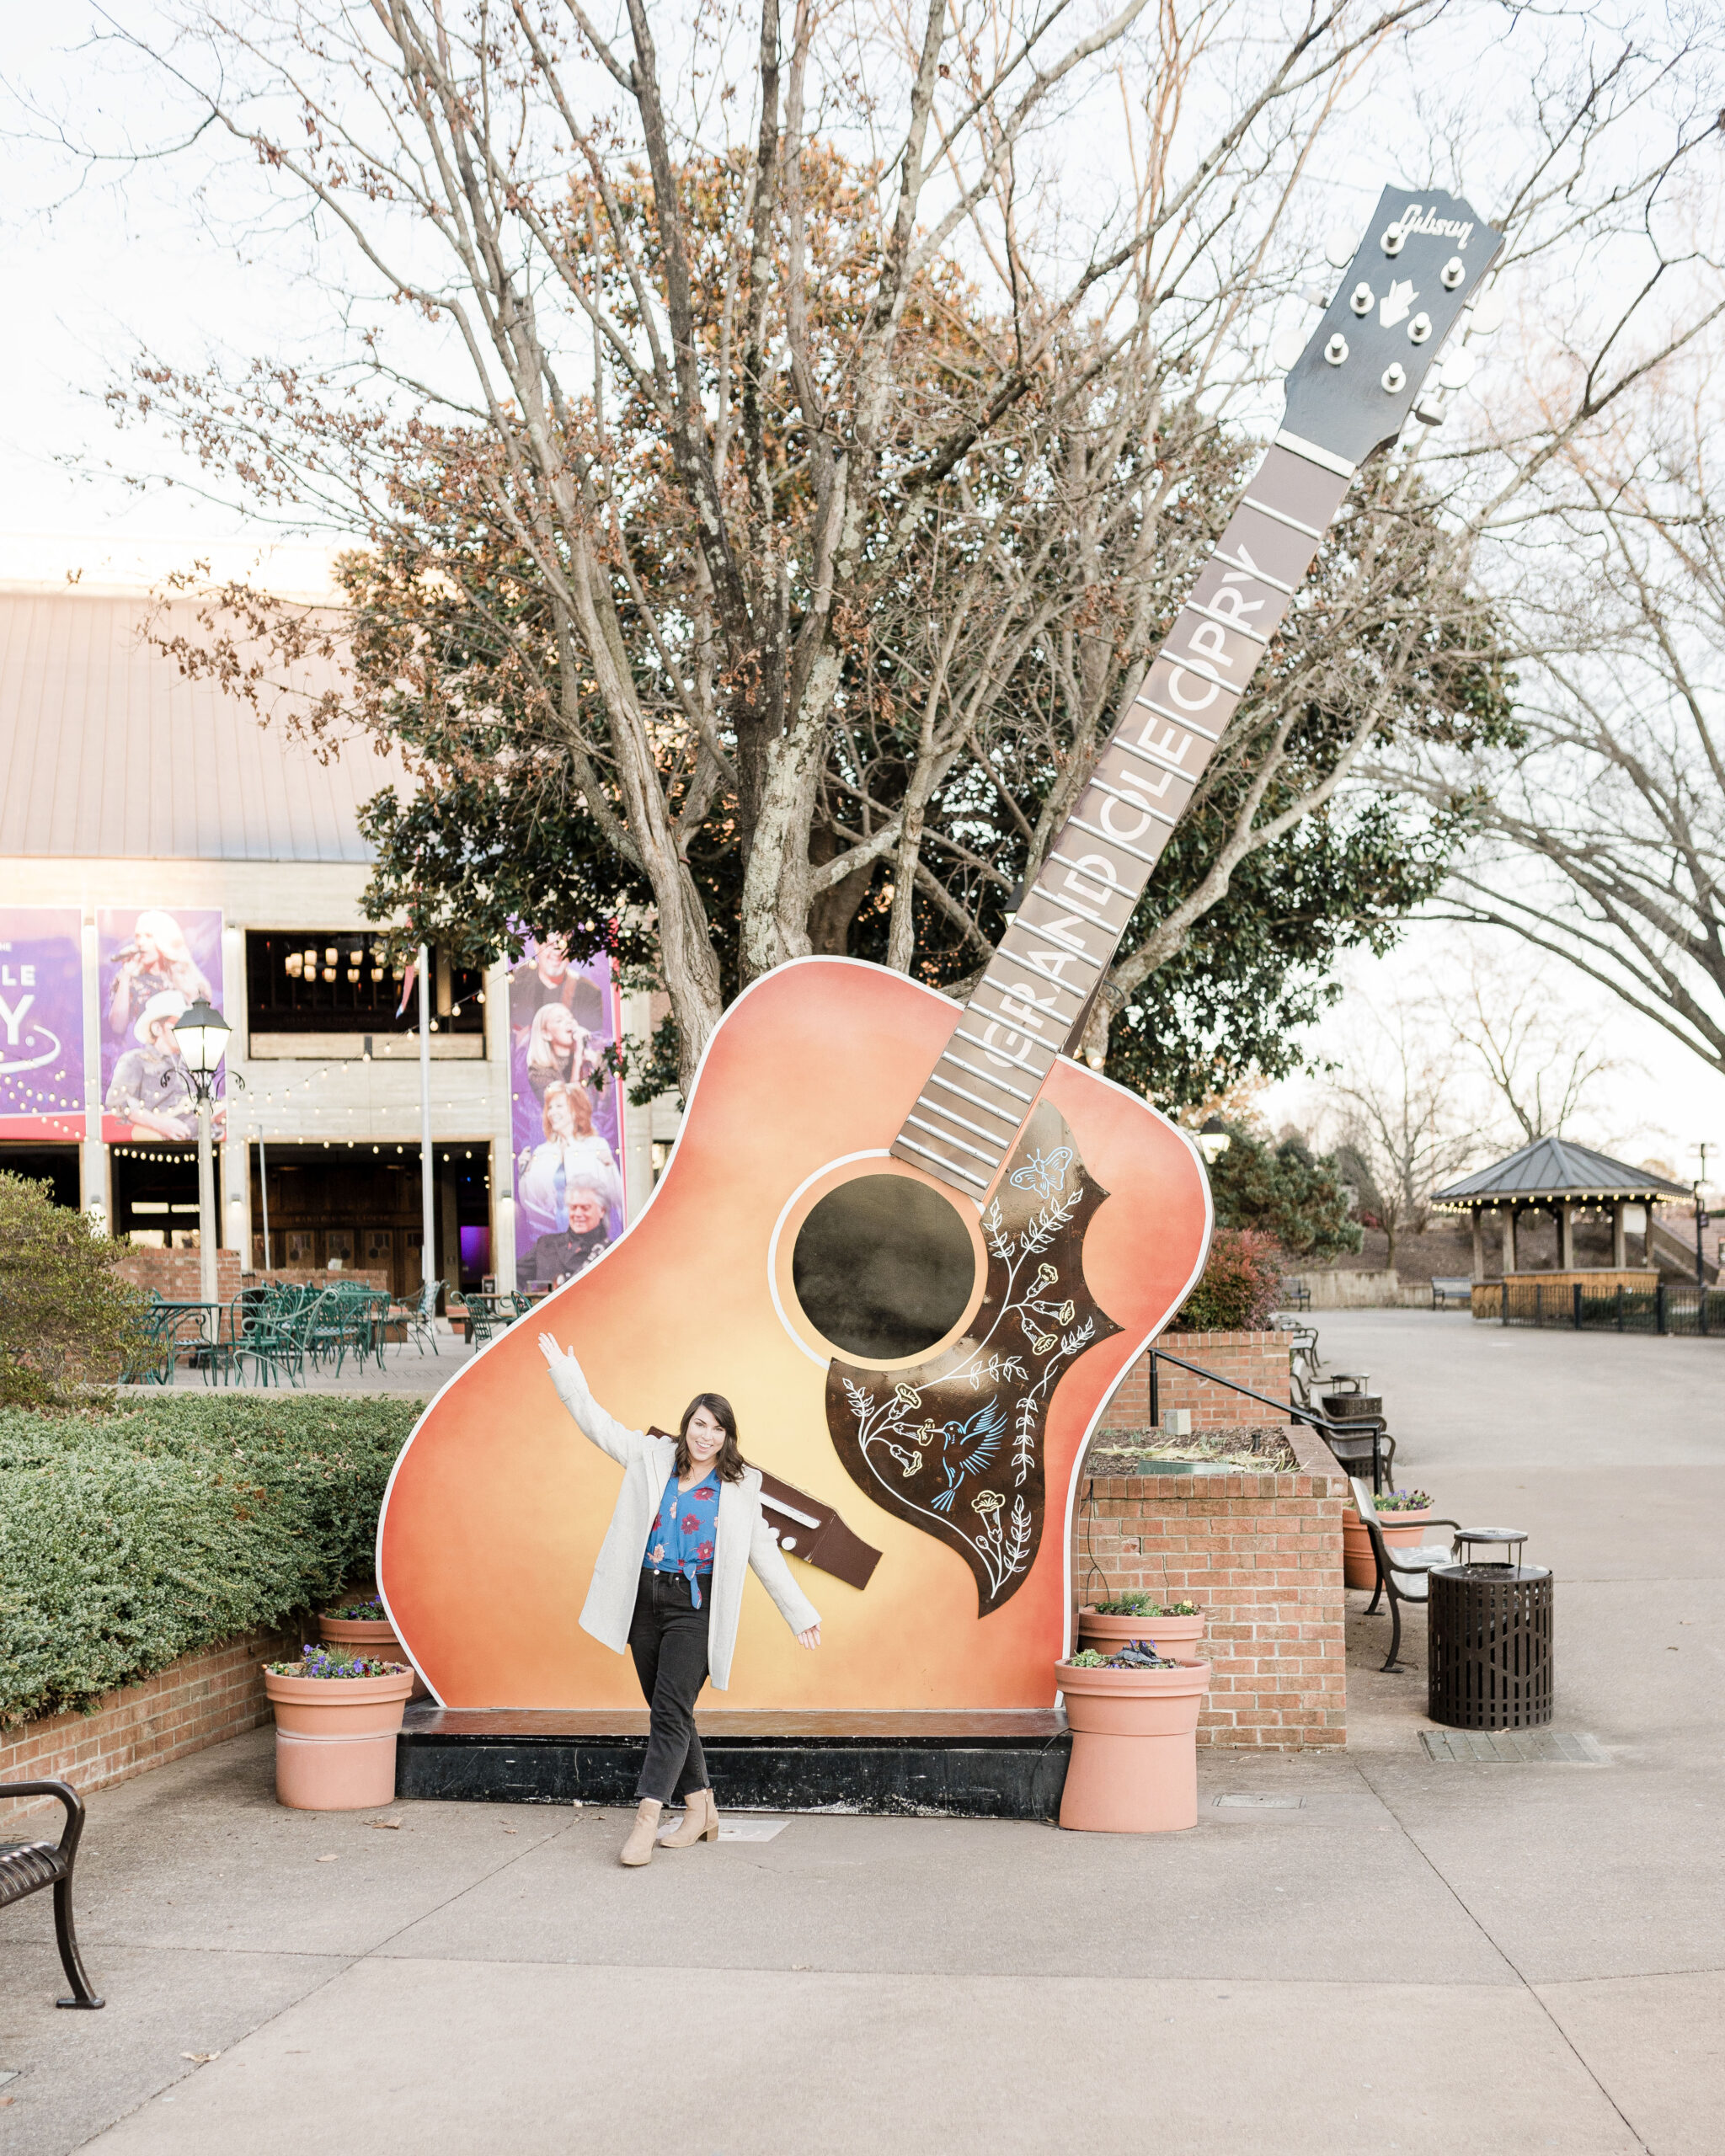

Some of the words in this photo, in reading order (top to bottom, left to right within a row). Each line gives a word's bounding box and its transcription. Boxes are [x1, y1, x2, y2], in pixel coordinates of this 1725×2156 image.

[1396, 204, 1474, 250] Gibson
[983, 854, 1117, 1068] GRAND
[1100, 717, 1194, 841] OLE
[1168, 543, 1265, 711] OPRY
[2, 964, 36, 986] LE
